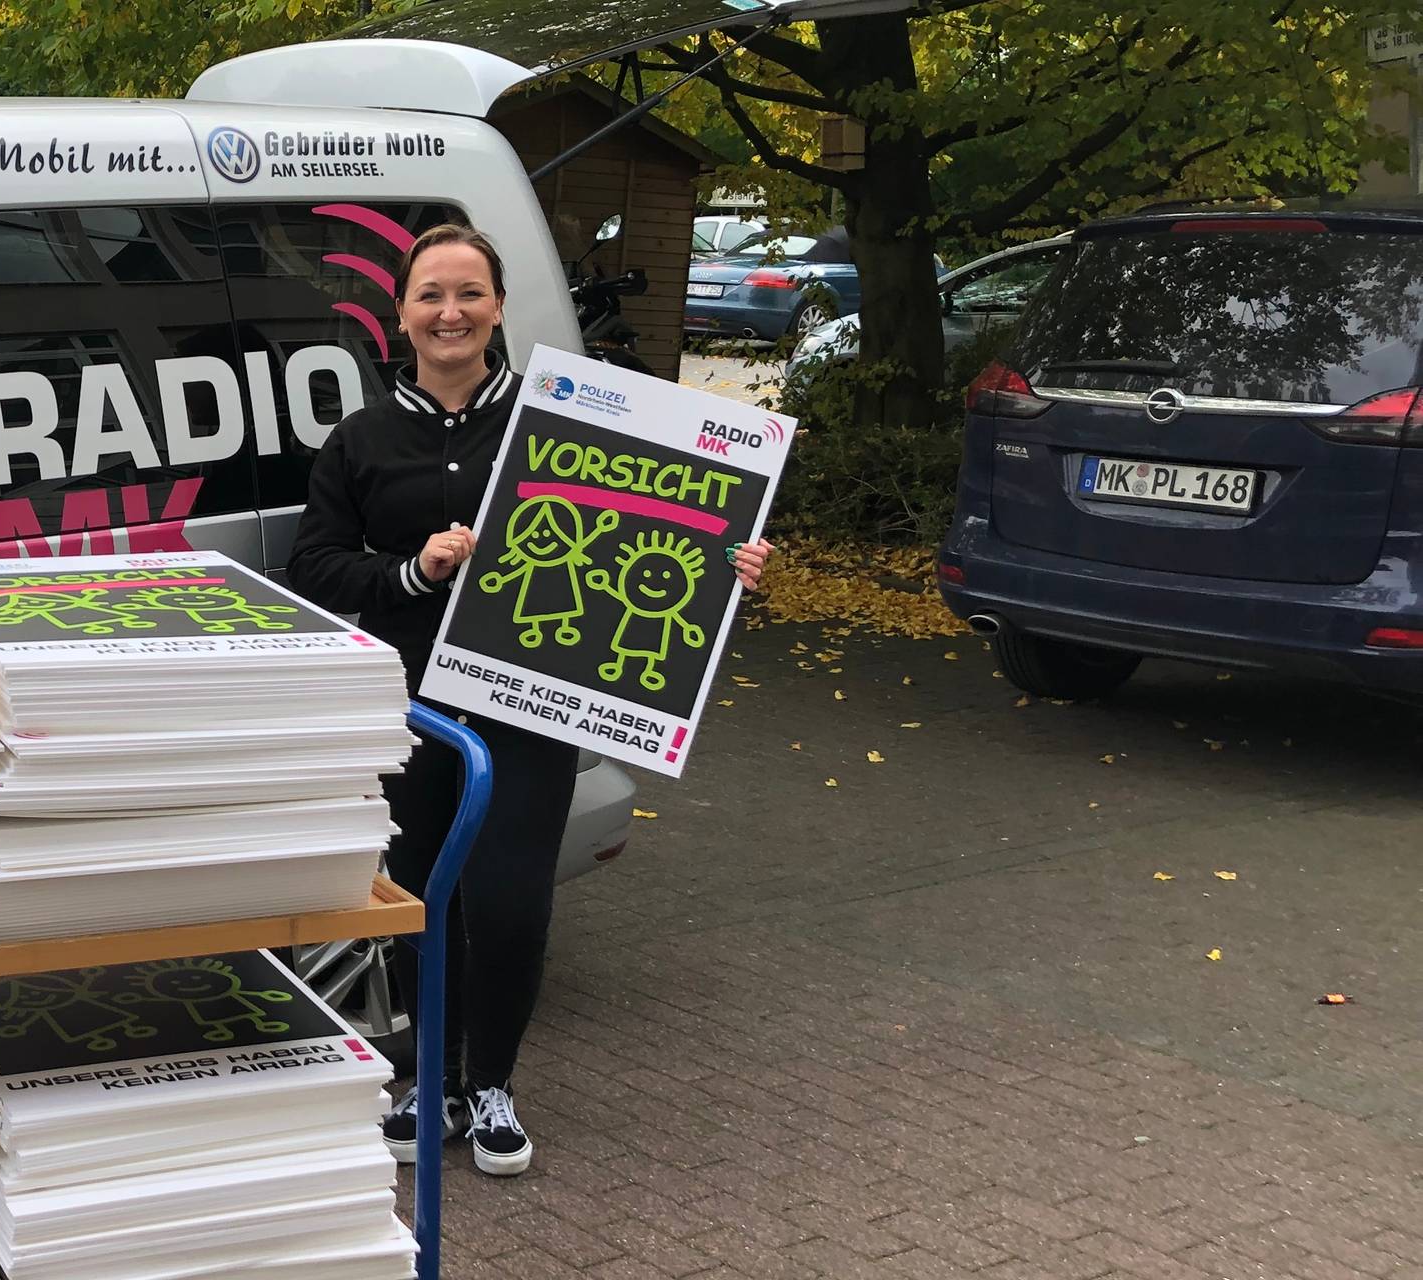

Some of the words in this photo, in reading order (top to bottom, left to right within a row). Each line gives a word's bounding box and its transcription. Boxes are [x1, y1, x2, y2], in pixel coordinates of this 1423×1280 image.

[264, 130, 376, 157] Gebrüder
[385, 132, 446, 157] Nolte
[107, 145, 195, 173] mit...
[270, 162, 299, 177] AM
[301, 162, 385, 177] SEILERSEE.
[579, 384, 626, 405] POLIZEI
[696, 434, 731, 456] MK
[701, 419, 763, 449] RADIO
[996, 443, 1028, 454] ZAFIRA
[527, 434, 742, 508] VORSICHT
[1096, 462, 1135, 493] MK
[1151, 467, 1187, 498] PL
[1191, 471, 1250, 505] 168
[96, 647, 216, 655] KEINEN
[229, 642, 347, 651] AIRBAG
[141, 639, 217, 647] KIDS
[227, 635, 337, 644] HABEN
[436, 654, 525, 692] UNSERE
[530, 684, 581, 710] KIDS
[588, 702, 666, 738] HABEN
[489, 690, 570, 726] KEINEN
[575, 717, 660, 754] AIRBAG
[6, 1067, 133, 1091] UNSERE
[144, 1057, 218, 1073] KIDS
[226, 1044, 335, 1063] HABEN
[101, 1069, 219, 1090] KEINEN
[231, 1054, 345, 1075] AIRBAG
